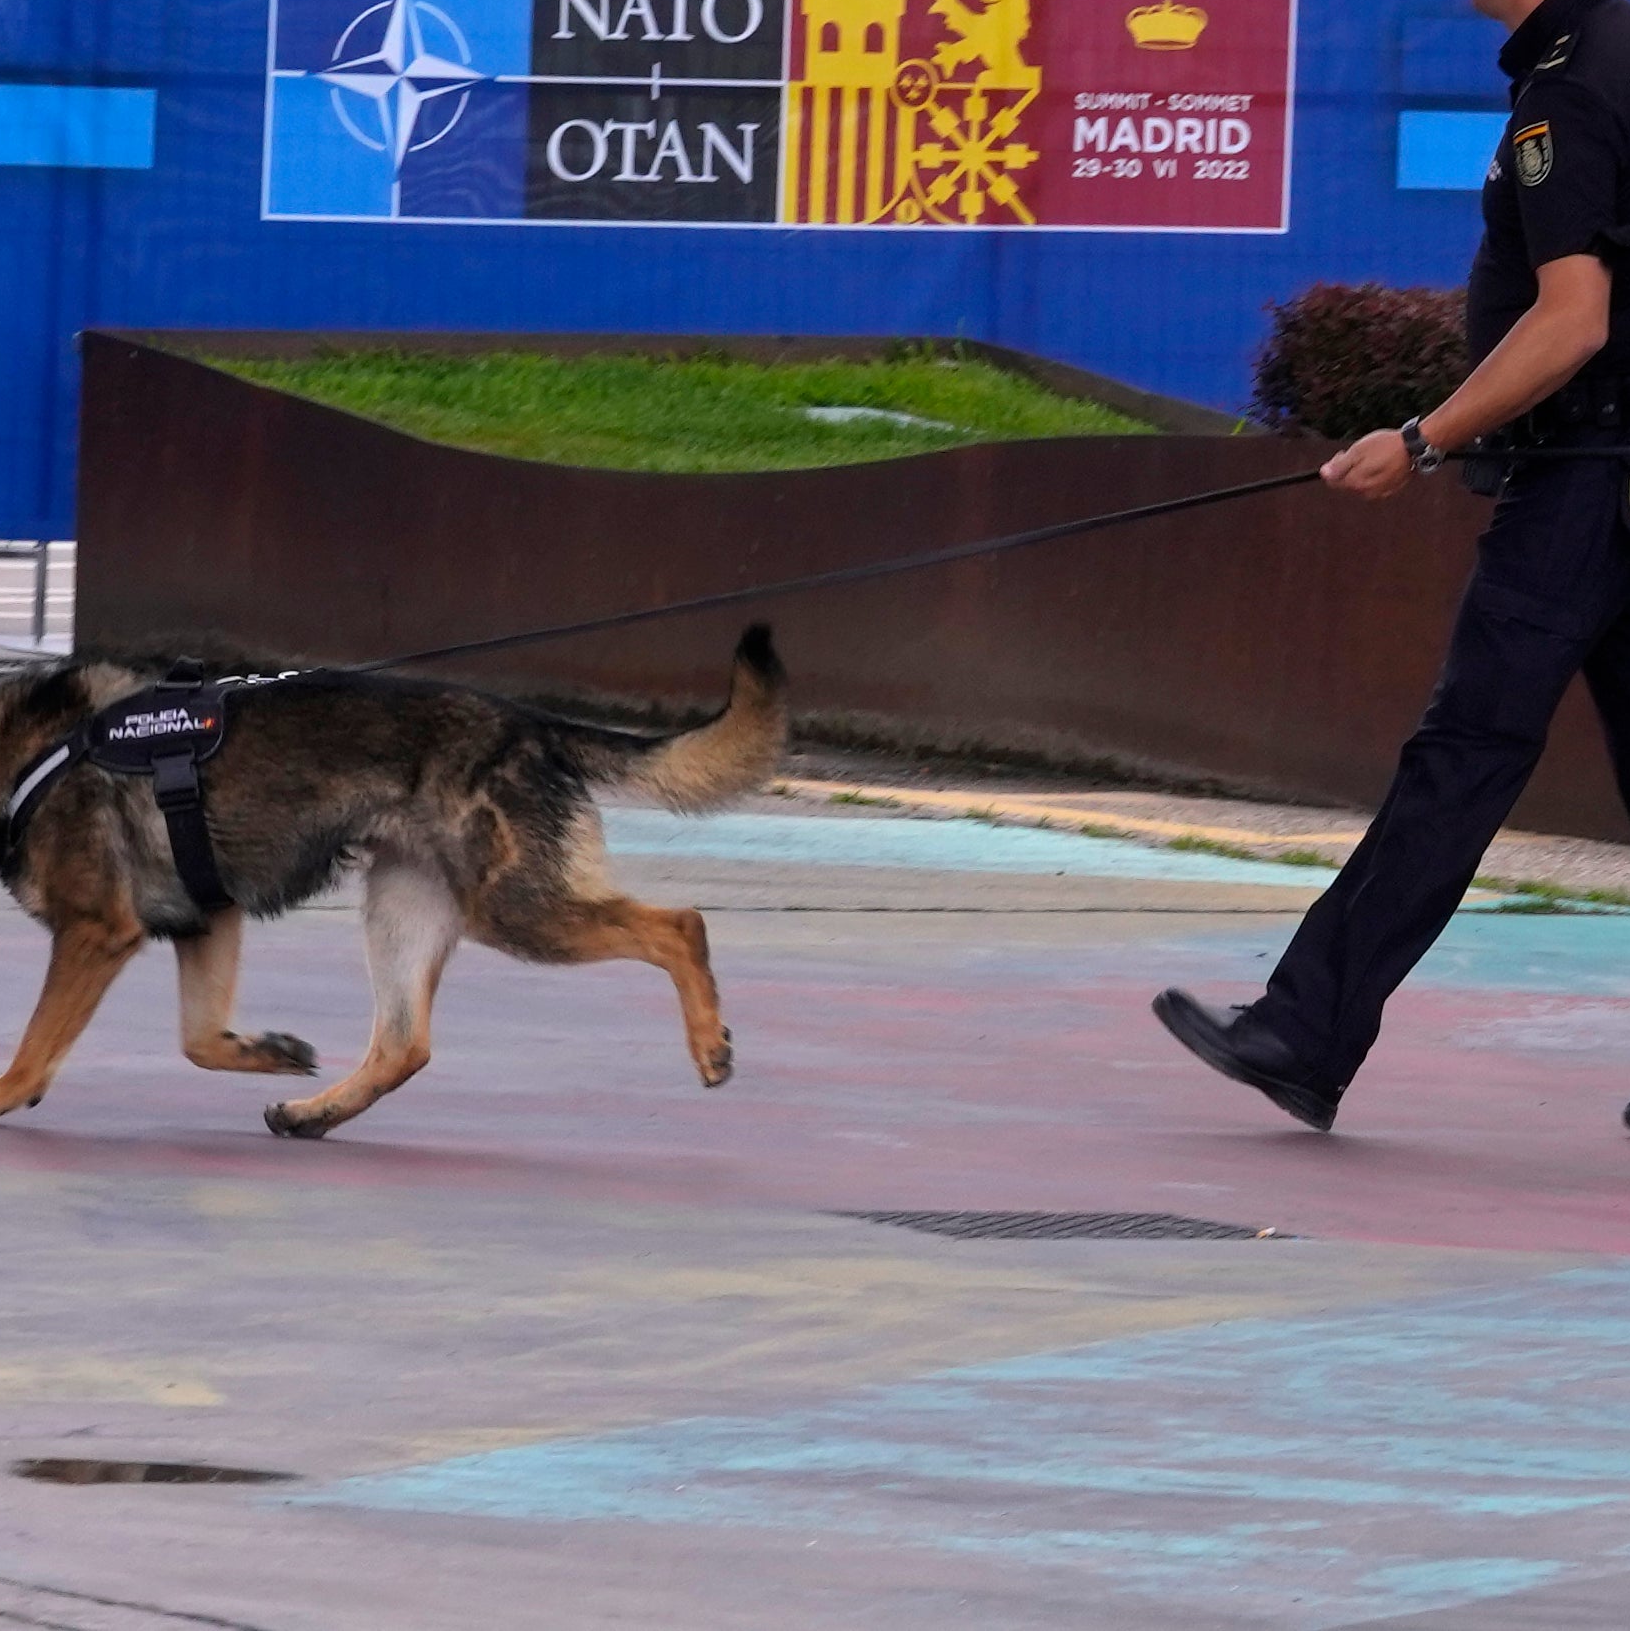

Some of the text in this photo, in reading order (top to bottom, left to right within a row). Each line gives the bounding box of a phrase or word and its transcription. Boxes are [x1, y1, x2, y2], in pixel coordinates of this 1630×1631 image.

[1074, 92, 1153, 110] SUMMIT
[1167, 93, 1254, 112] SOMMET
[1072, 116, 1252, 154] MADRID
[546, 118, 761, 185] OTAN
[1072, 157, 1250, 180] 29-30 VI 2022
[109, 719, 207, 741] NACIONAL
